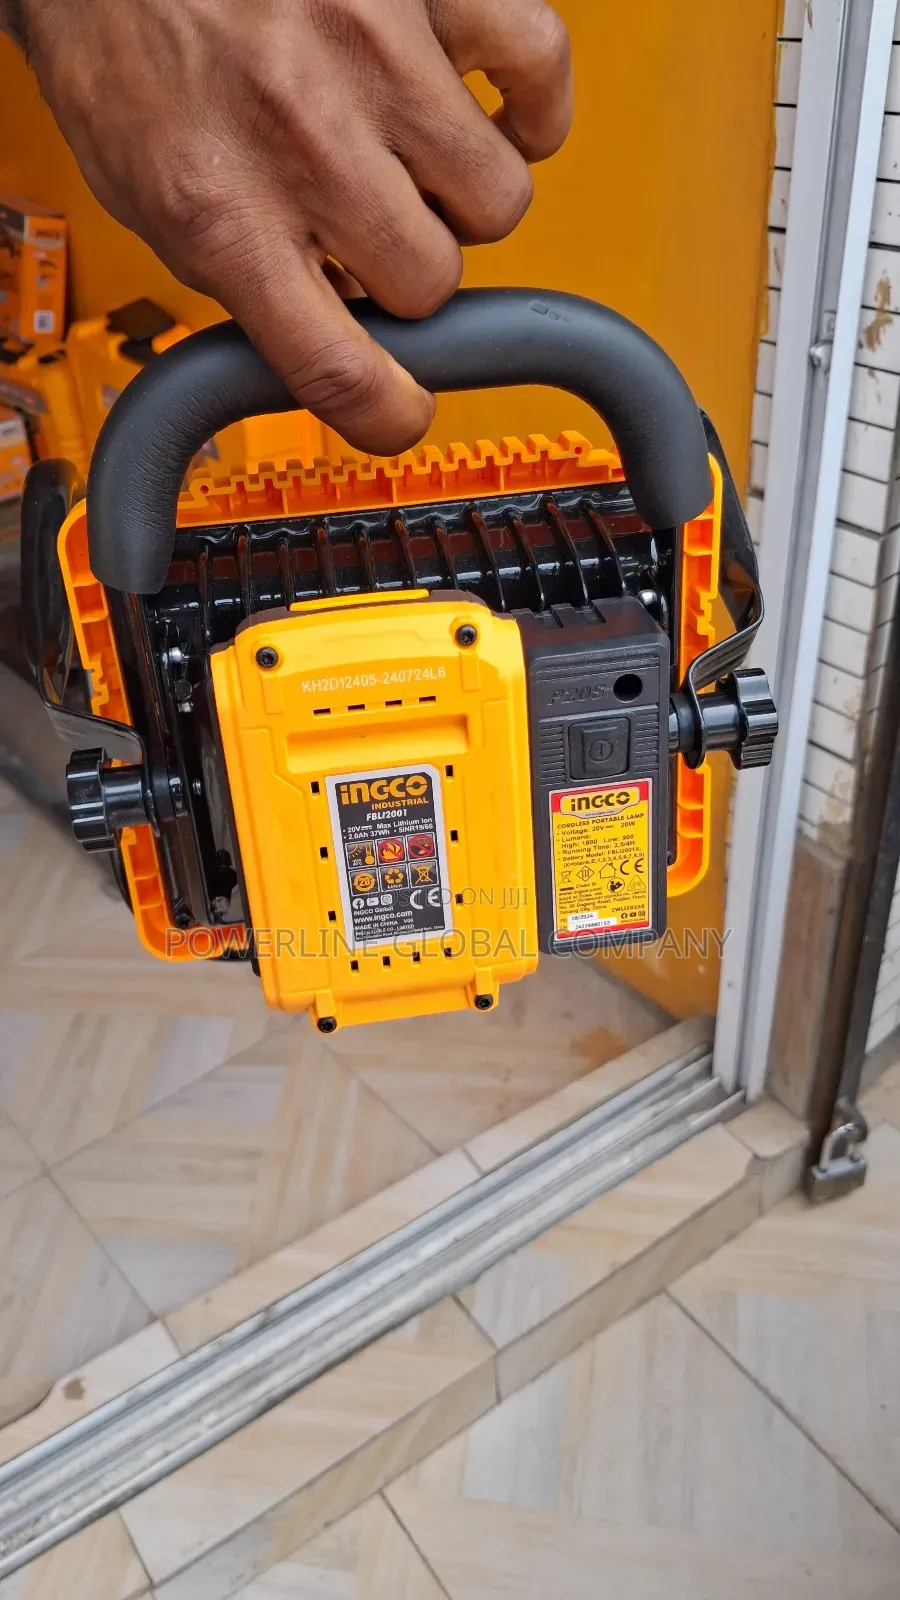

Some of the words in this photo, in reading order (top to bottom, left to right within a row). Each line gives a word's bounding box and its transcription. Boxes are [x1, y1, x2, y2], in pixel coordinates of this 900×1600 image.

[302, 666, 446, 693] KH2D12405-240724L6
[372, 797, 428, 810] INDUSTRIAL
[393, 819, 420, 828] Lithium
[421, 817, 433, 825] Ion
[557, 821, 589, 830] CORDLESS
[591, 815, 624, 825] PORTABLE
[626, 812, 645, 820] LAMP
[348, 832, 369, 841] 2.0Ah
[561, 829, 590, 837] Voltage:
[561, 834, 591, 843] Lumens:
[561, 842, 580, 850] High:
[603, 836, 619, 844] Low:
[562, 847, 591, 856] Running
[562, 855, 584, 863] Battery
[585, 851, 606, 859] Model:
[353, 908, 374, 916] INGCO
[353, 910, 413, 924] www.ingco.com
[355, 923, 371, 931] MADE
[380, 920, 399, 928] CHINA
